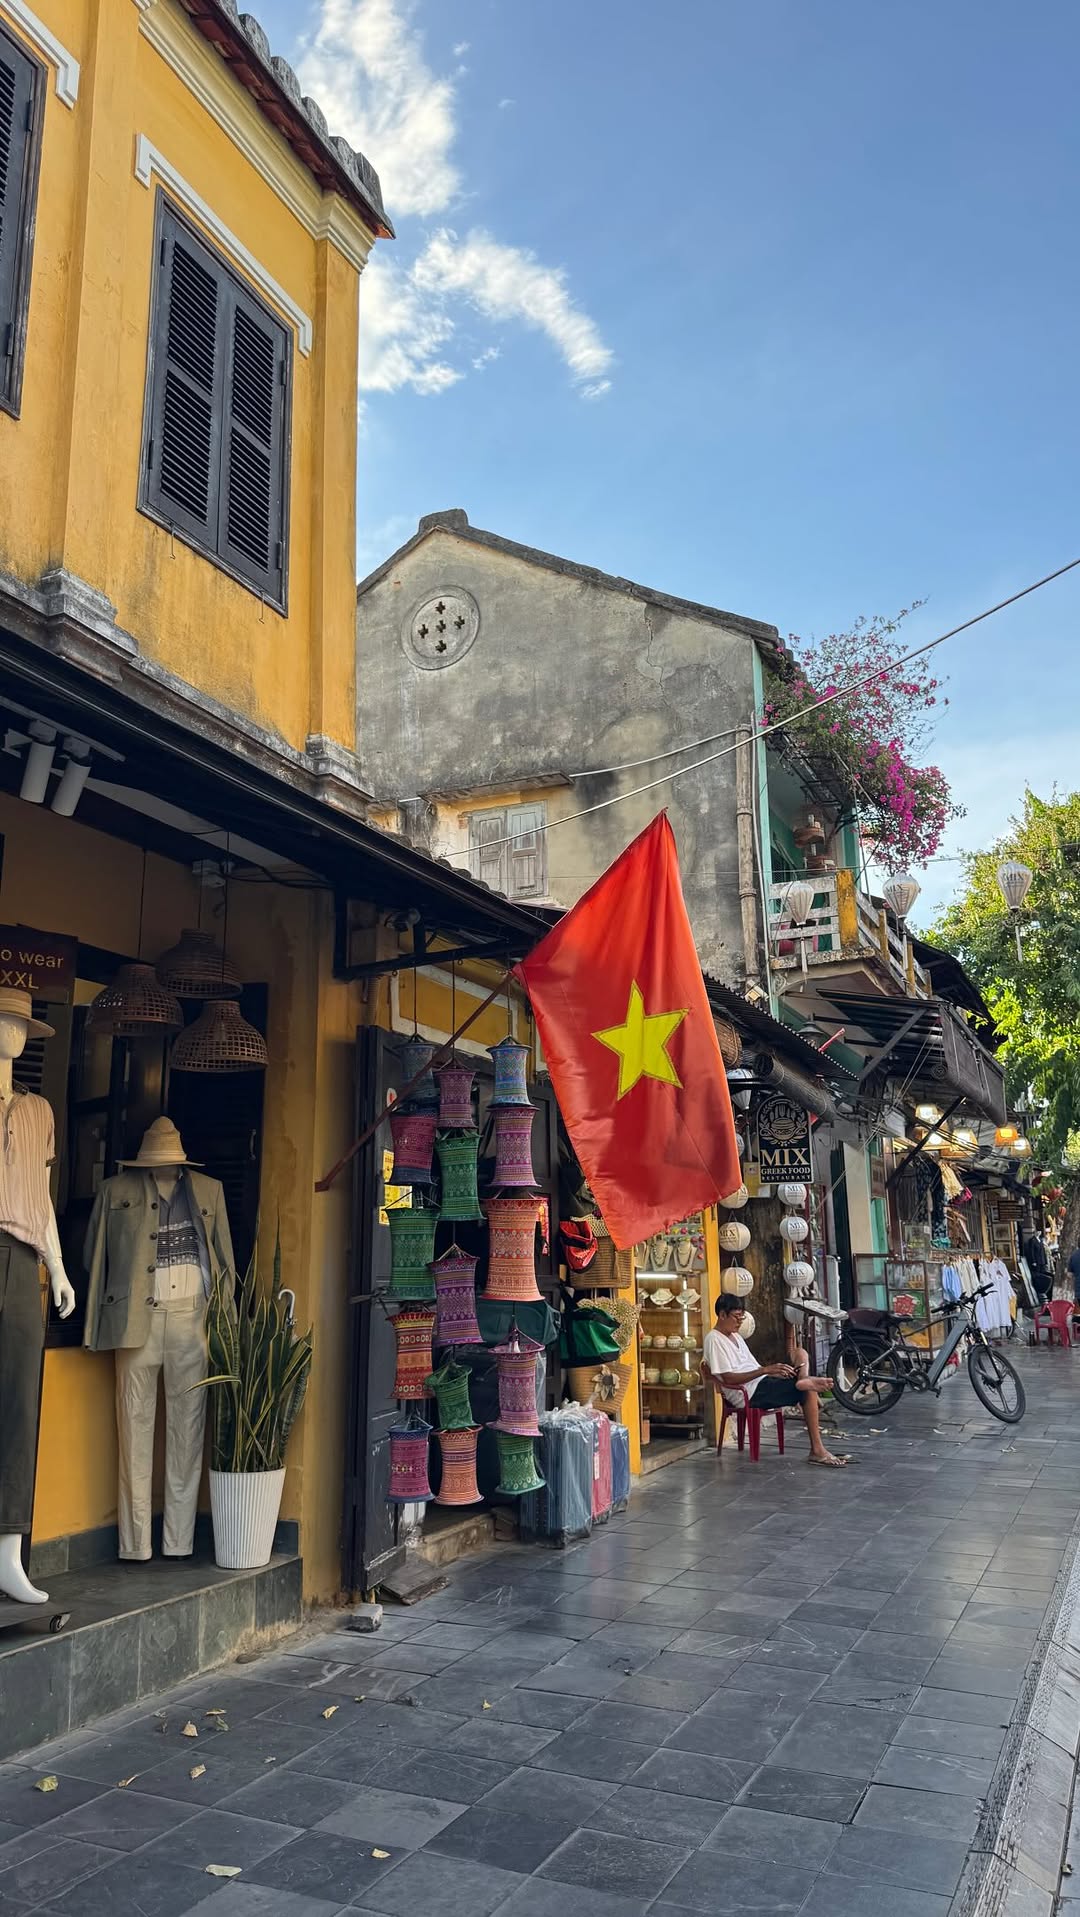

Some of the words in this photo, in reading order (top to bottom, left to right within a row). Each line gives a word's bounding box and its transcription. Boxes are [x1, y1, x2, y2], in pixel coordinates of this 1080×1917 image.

[19, 951, 64, 969] wear
[760, 1147, 810, 1167] MIX
[761, 1167, 787, 1175] GREEK
[788, 1166, 811, 1175] FOOD
[787, 1185, 804, 1193] MIX
[790, 1222, 806, 1230] MIX
[720, 1229, 736, 1238] MIX
[788, 1268, 805, 1276] MIX
